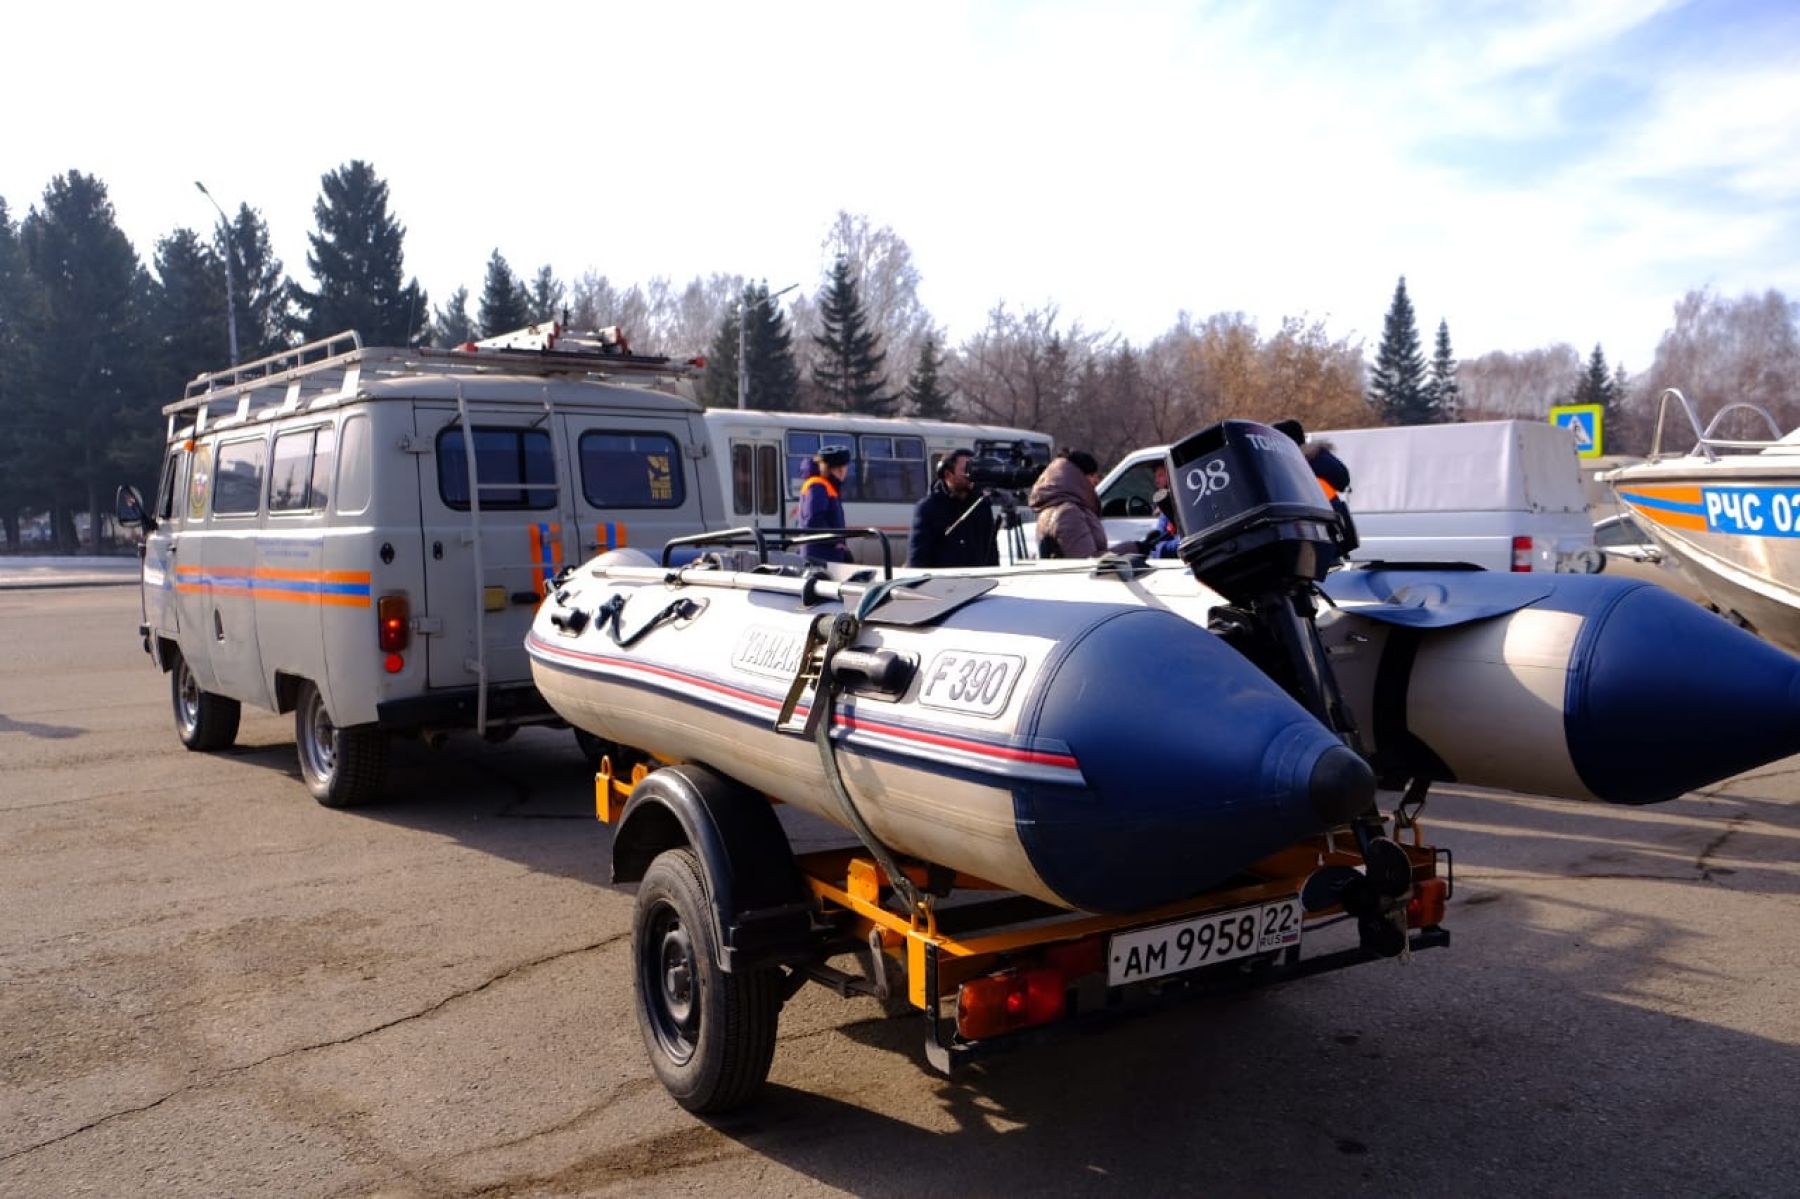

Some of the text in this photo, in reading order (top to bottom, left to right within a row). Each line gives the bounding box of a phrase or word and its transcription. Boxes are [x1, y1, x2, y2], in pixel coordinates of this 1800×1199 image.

[1705, 492, 1763, 530] РЧС
[925, 656, 1007, 706] F 390
[1264, 904, 1294, 935] 22
[1176, 915, 1255, 966] 9958
[1260, 934, 1282, 947] RUS
